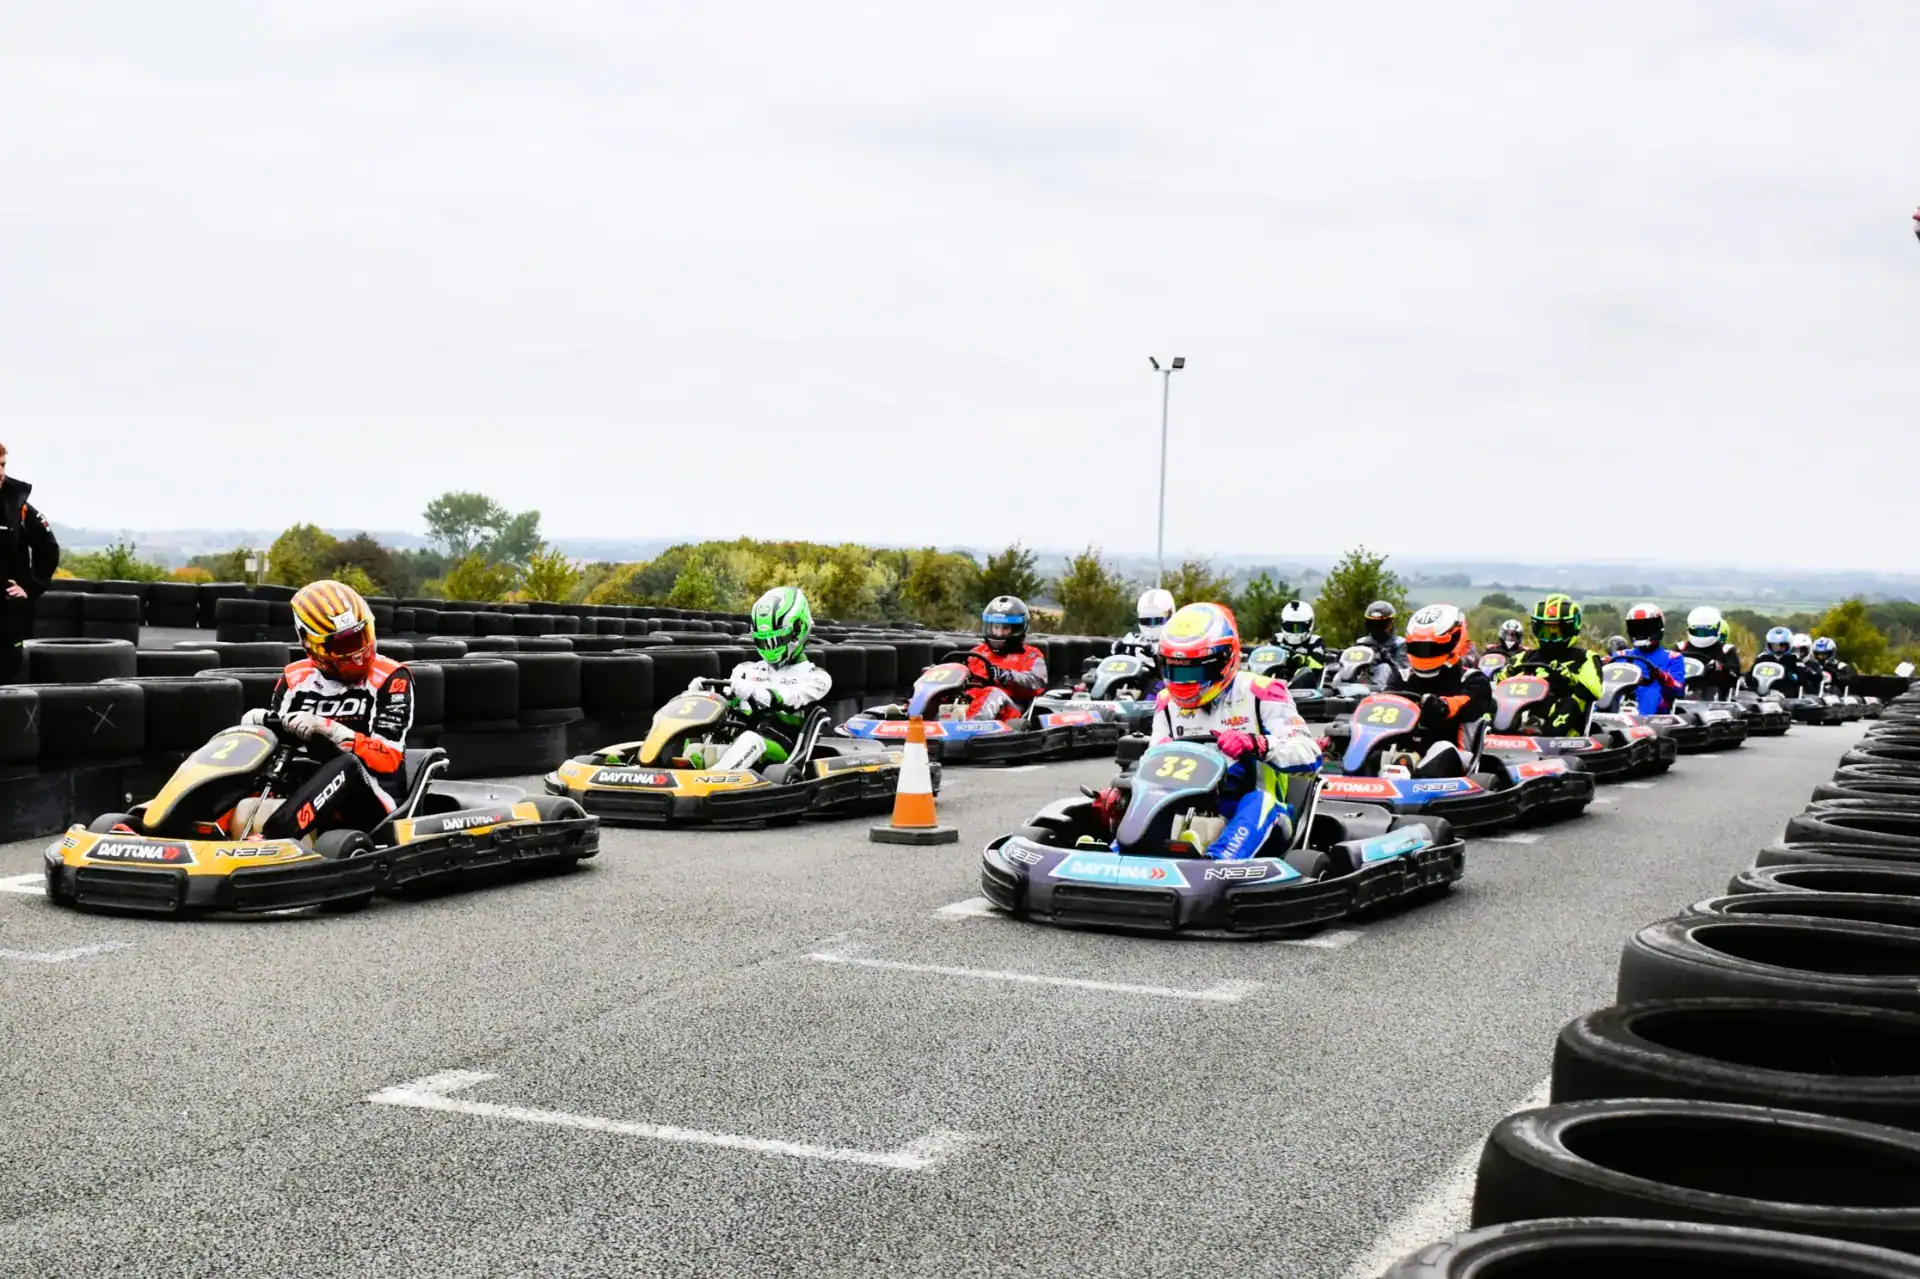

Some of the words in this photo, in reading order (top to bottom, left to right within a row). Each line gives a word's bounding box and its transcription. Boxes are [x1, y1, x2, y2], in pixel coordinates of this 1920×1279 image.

[1611, 670, 1625, 680] 7
[1508, 683, 1529, 695] 12
[1368, 706, 1399, 724] 28
[210, 740, 239, 760] 2
[1155, 756, 1198, 780] 32
[598, 772, 654, 784] DAYTONA
[313, 770, 346, 811] SODI
[442, 816, 494, 831] DAYTONA
[96, 842, 164, 859] DAYTONA
[1070, 860, 1149, 879] DAYTONA
